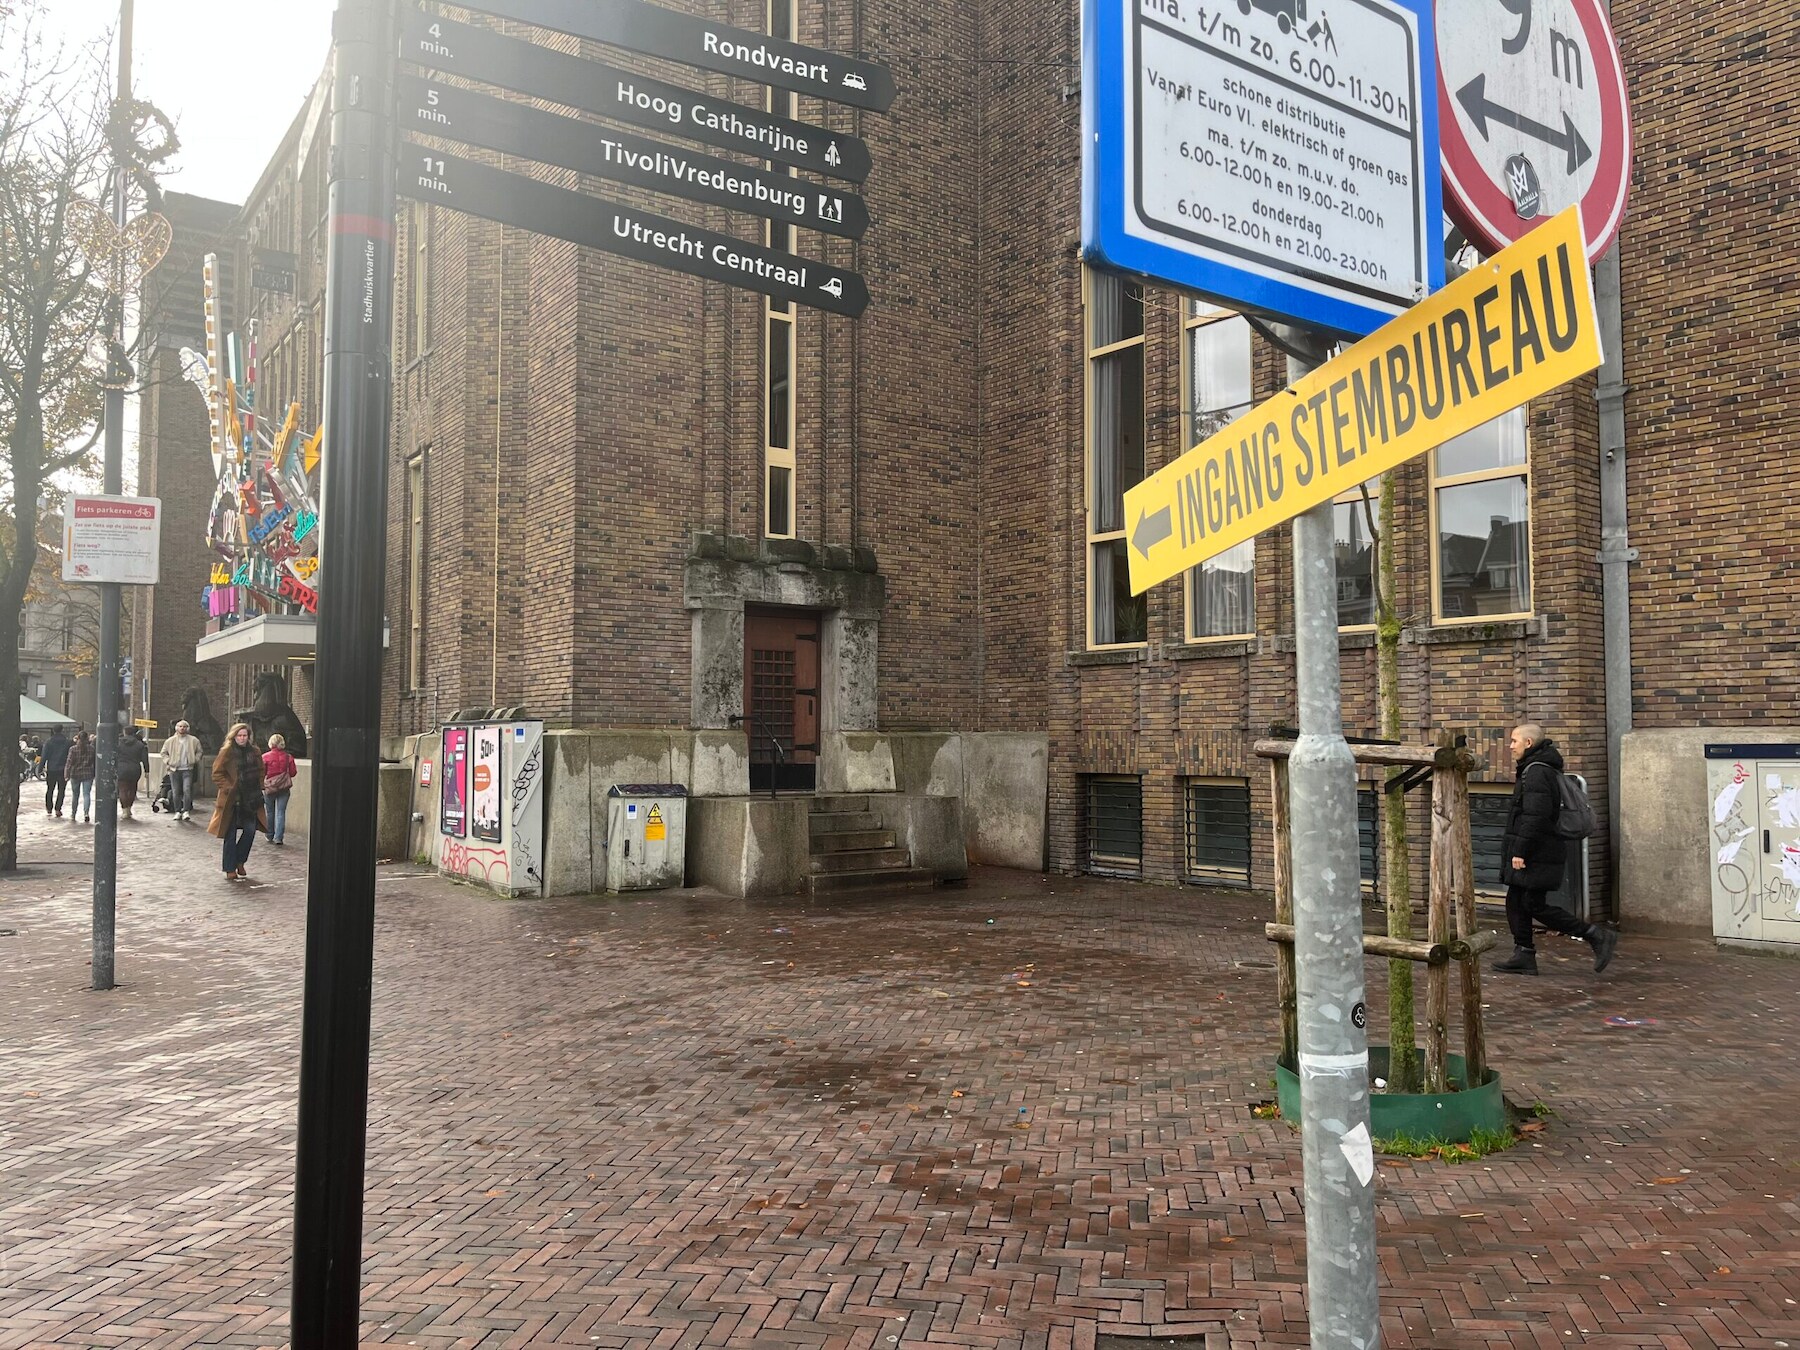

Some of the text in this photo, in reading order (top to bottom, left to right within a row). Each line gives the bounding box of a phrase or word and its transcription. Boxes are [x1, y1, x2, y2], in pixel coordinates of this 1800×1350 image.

[420, 39, 453, 58] min.
[428, 23, 441, 38] 4
[1198, 7, 1241, 47] t/m
[1250, 35, 1279, 64] zo.
[703, 31, 829, 83] Rondvaart
[1550, 28, 1583, 90] m
[417, 107, 451, 125] min.
[427, 89, 439, 105] 5
[617, 81, 809, 154] Hoog Catharijne
[1223, 78, 1346, 138] schone distributie
[1147, 67, 1192, 101] Vanaf
[1198, 89, 1231, 117] Euro
[1262, 119, 1328, 156] elektrisch
[1333, 148, 1345, 162] of
[1348, 155, 1383, 177] groen
[1387, 169, 1408, 186] gas
[418, 174, 453, 194] min.
[423, 157, 445, 176] 11
[600, 139, 806, 215] TivoliVredenburg
[1208, 128, 1359, 196] ma. t/m zo. m.u.v. do.
[1277, 180, 1293, 197] en
[1252, 199, 1322, 240] donderdag
[1275, 235, 1292, 251] en
[613, 215, 807, 287] Utrecht Centraal
[363, 239, 374, 324] Stadhuiskwartier
[1176, 242, 1578, 549] INGANG STEMBUREAU
[96, 507, 132, 515] parkeren
